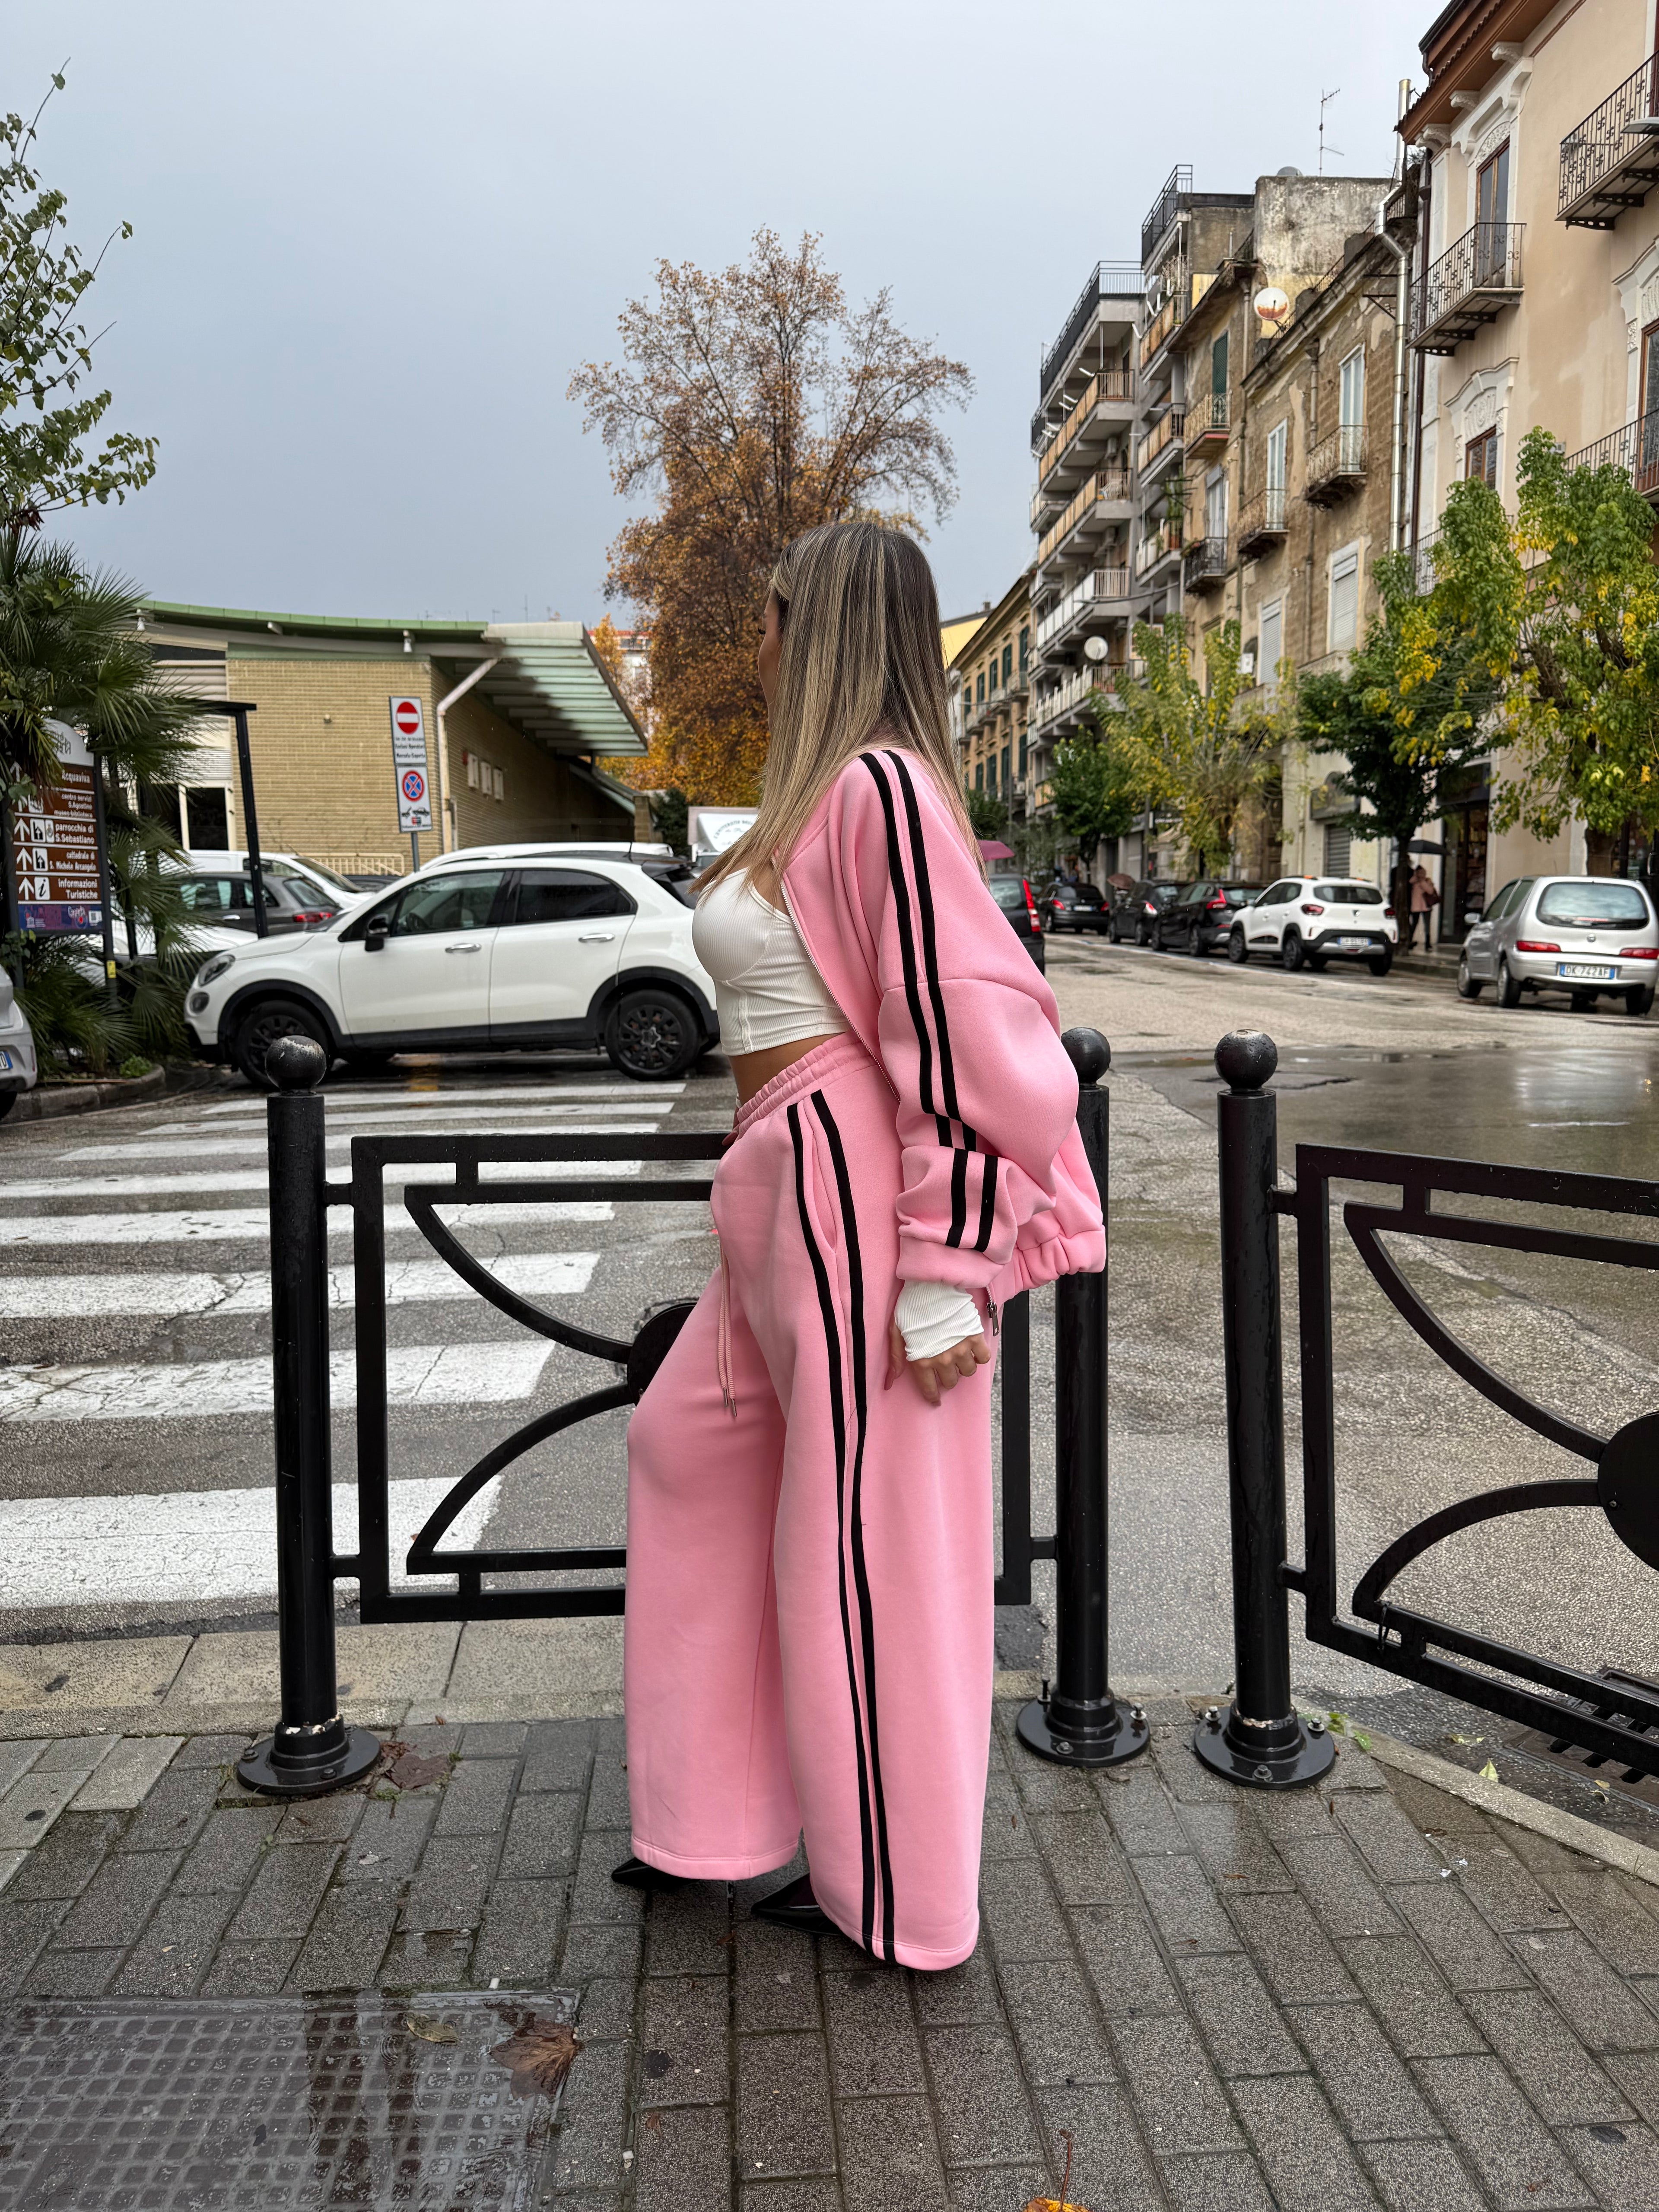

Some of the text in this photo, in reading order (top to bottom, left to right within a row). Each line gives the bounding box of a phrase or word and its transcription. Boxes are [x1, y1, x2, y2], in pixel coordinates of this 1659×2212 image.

[61, 769, 90, 783] Acquaviva
[55, 823, 94, 833] parrocchia di
[55, 833, 95, 844] S.Sebastiano
[67, 851, 89, 860] cattedrale
[49, 861, 96, 872] S. Michele Arcangelo
[65, 889, 98, 899] Turistiche
